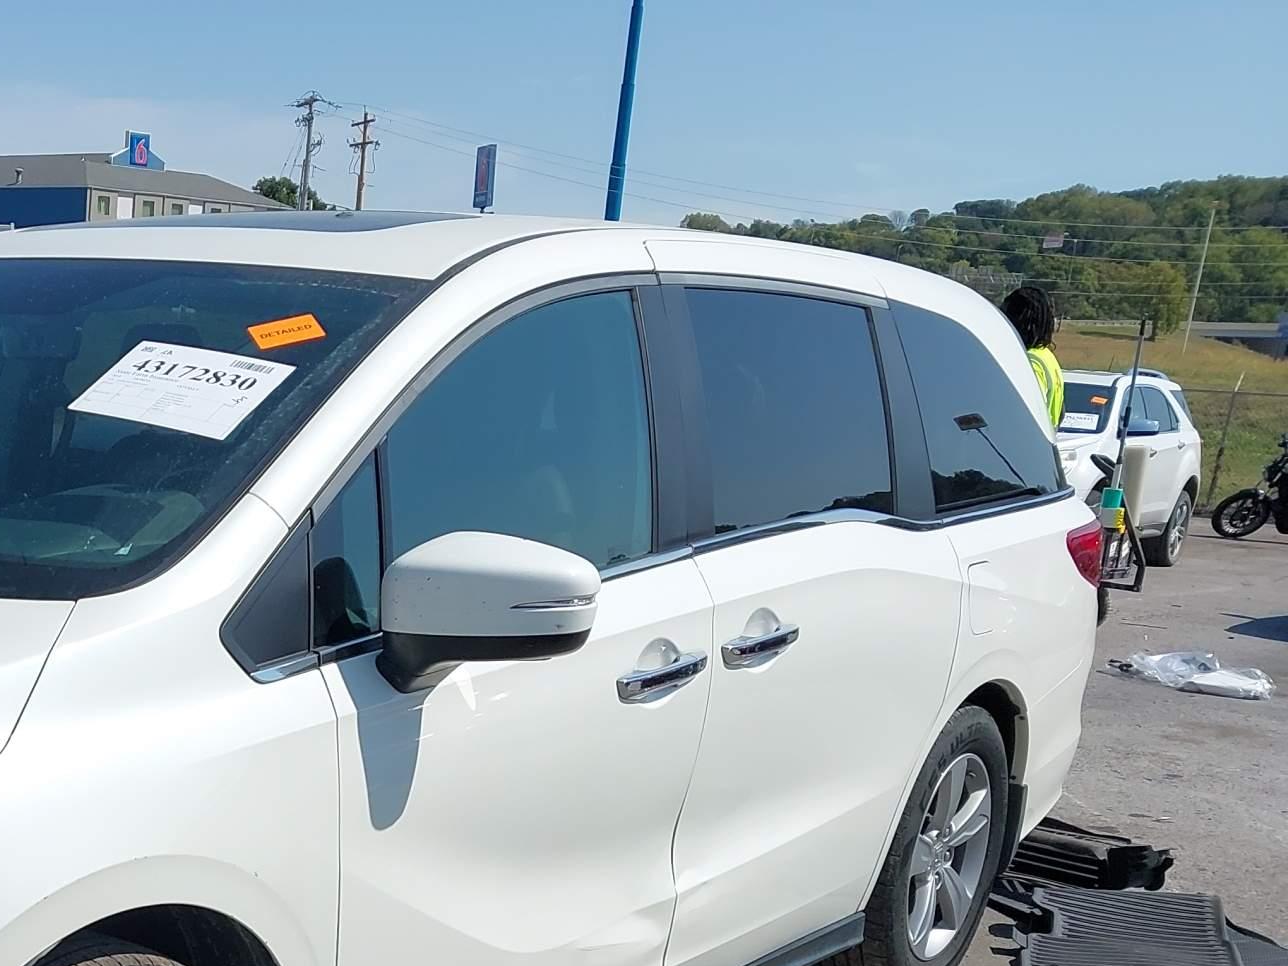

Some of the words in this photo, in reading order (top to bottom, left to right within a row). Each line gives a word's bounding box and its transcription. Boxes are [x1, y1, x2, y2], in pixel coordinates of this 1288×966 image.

[135, 138, 147, 164] 6
[260, 324, 312, 339] DETAILED
[131, 358, 258, 391] 43172830
